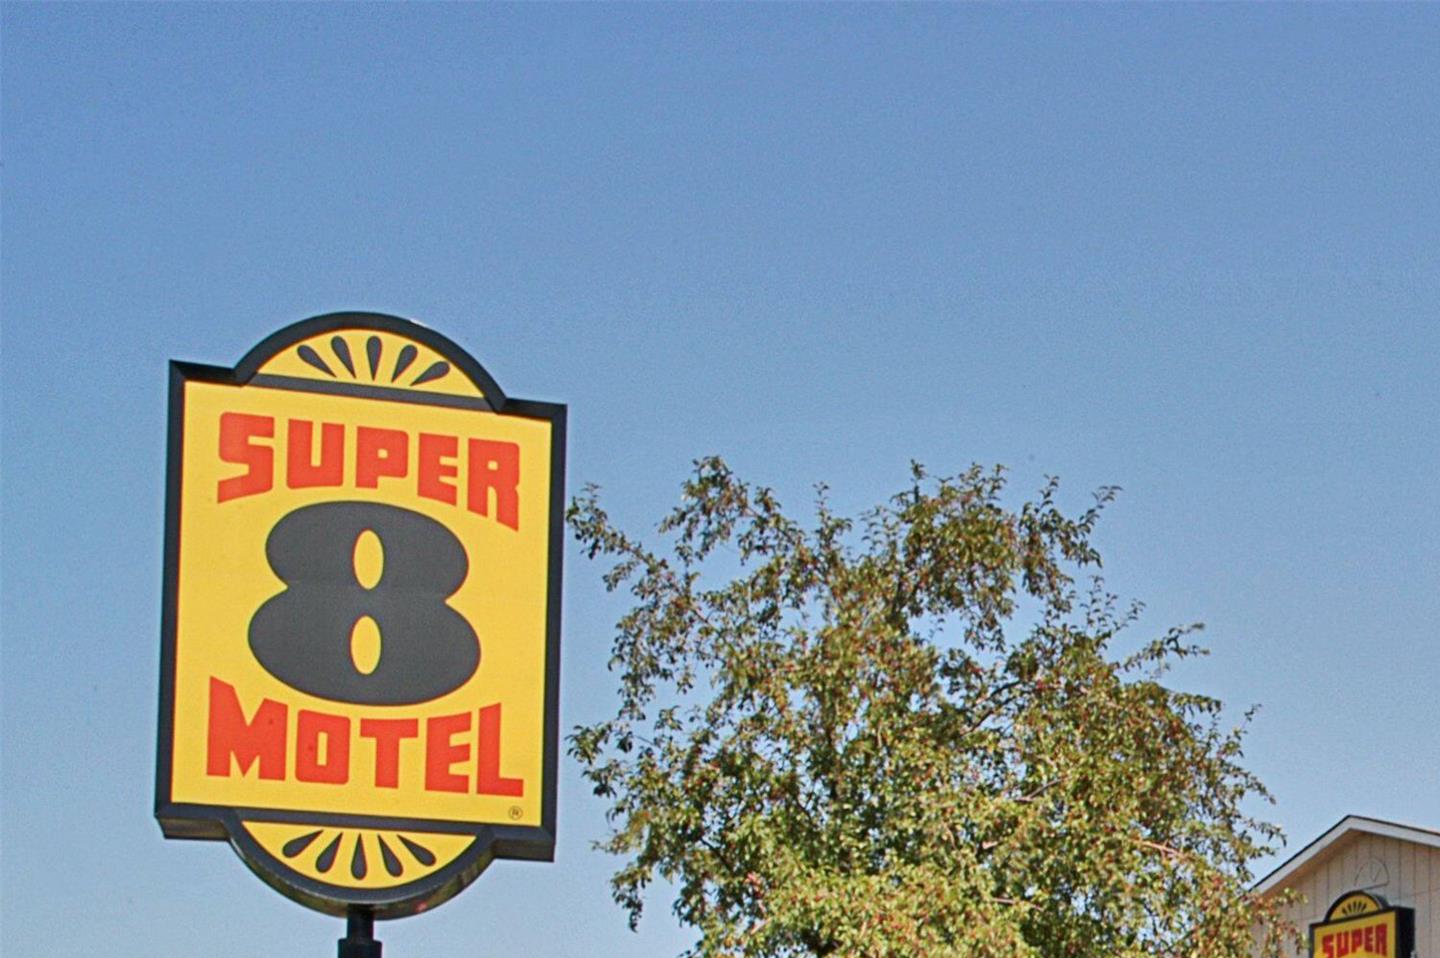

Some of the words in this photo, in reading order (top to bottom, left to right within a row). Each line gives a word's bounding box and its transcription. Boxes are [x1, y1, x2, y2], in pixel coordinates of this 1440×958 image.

[217, 412, 520, 531] SUPER
[248, 500, 482, 706] 8
[206, 676, 524, 797] MOTEL
